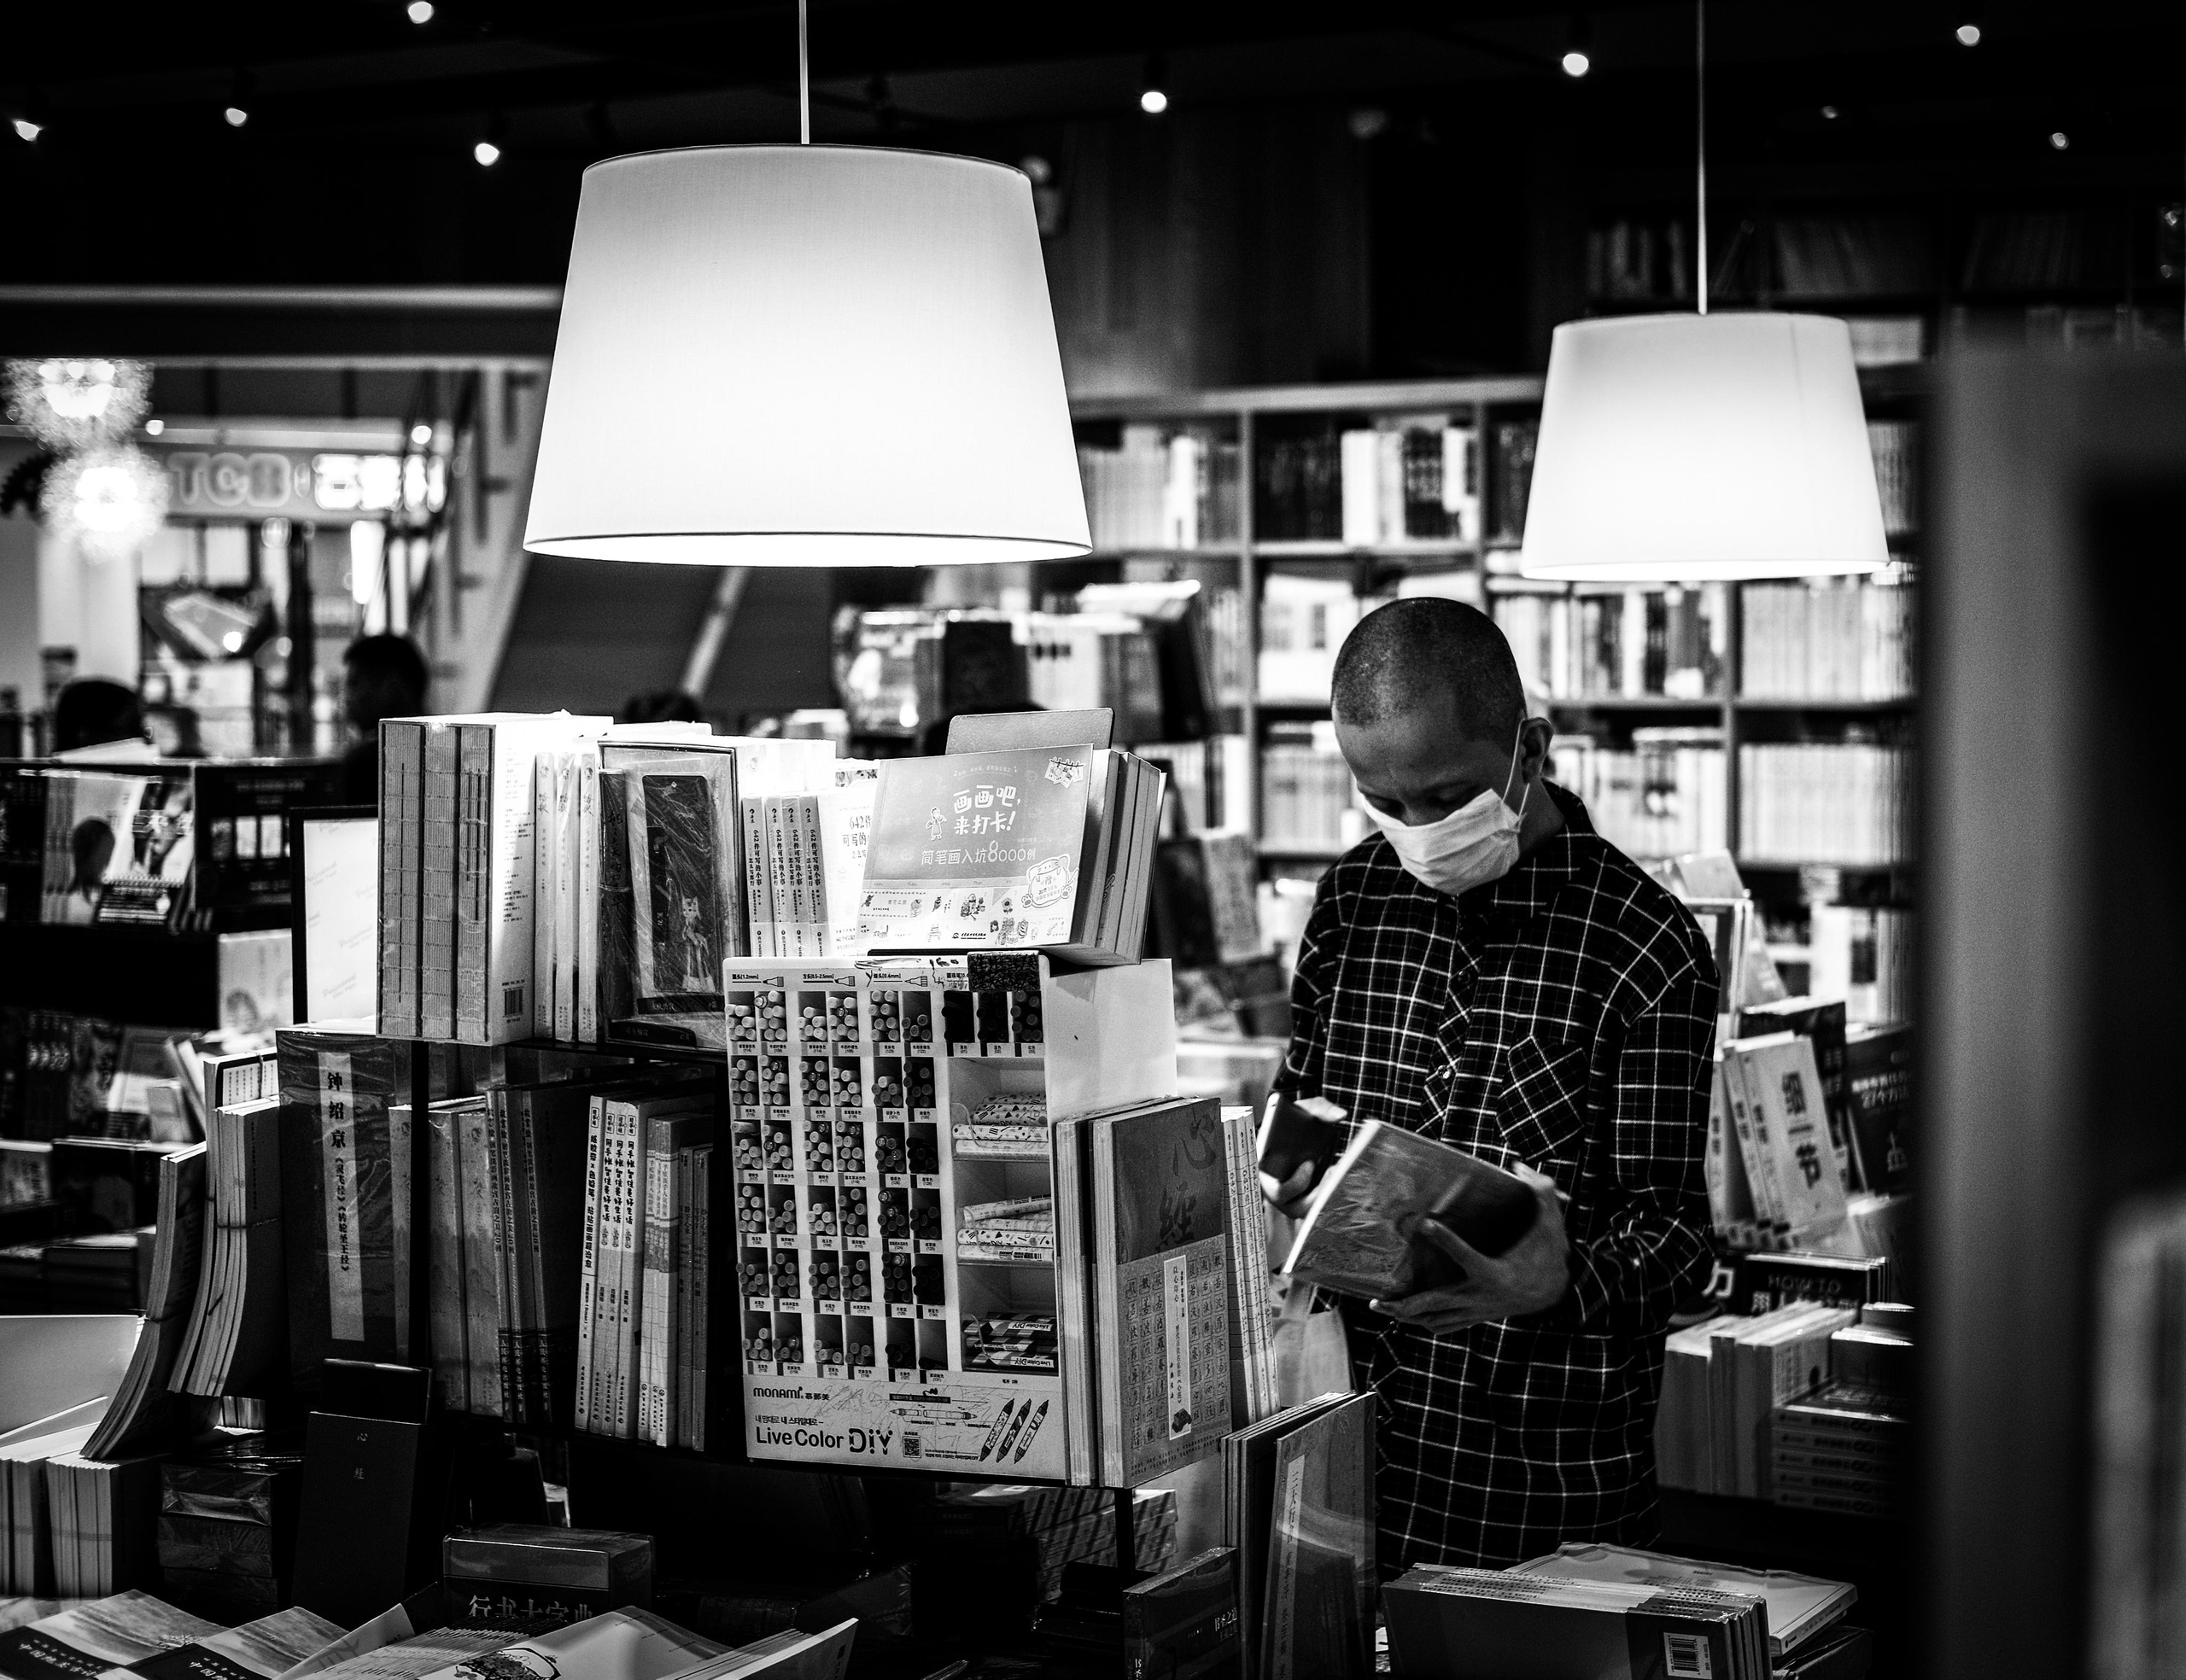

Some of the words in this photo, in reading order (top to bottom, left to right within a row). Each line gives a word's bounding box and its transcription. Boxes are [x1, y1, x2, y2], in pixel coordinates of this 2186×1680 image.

[327, 1072, 347, 1148] 钟绍京
[757, 1426, 792, 1444] Live
[795, 1429, 845, 1449] Color
